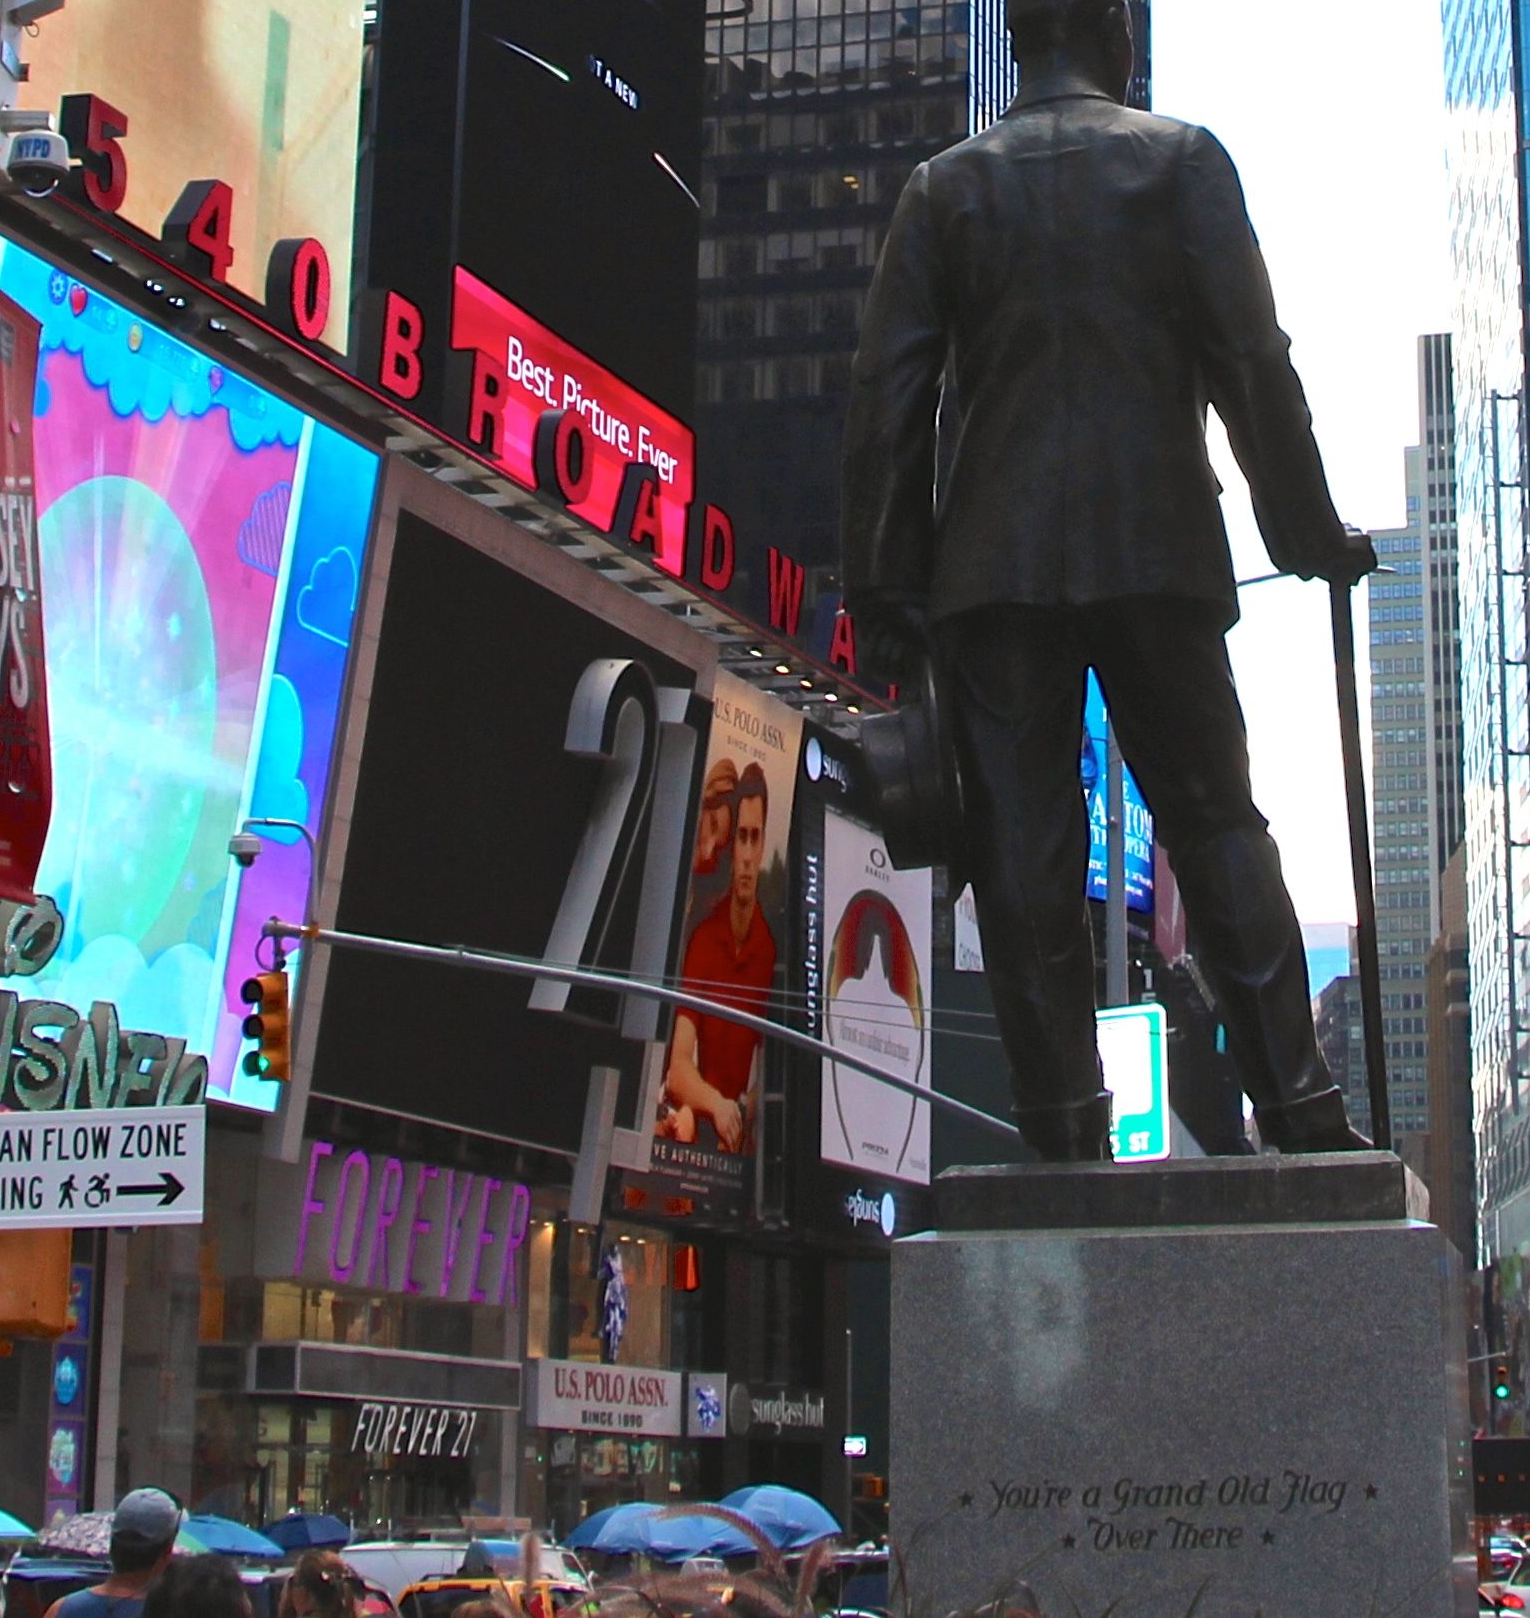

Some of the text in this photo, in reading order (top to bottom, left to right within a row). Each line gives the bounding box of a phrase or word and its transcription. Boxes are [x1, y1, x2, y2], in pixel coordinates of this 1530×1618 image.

[15, 137, 51, 160] NYPD
[507, 334, 558, 409] Best.
[636, 425, 679, 489] Ever
[733, 707, 759, 740] POLO
[804, 910, 819, 1030] unglass
[42, 1125, 112, 1162] FLOW
[119, 1122, 188, 1159] ZONE
[1129, 1131, 1151, 1154] ST
[292, 1140, 533, 1308] FOREVER
[554, 1367, 669, 1407] U.S. POLO ASSN.
[351, 1401, 478, 1459] FOREVER 21
[581, 1409, 614, 1426] SINCE
[750, 1390, 825, 1434] sunglass hut
[986, 1468, 1348, 1520] You're a Grand Old Flag
[1087, 1515, 1244, 1553] Over There
